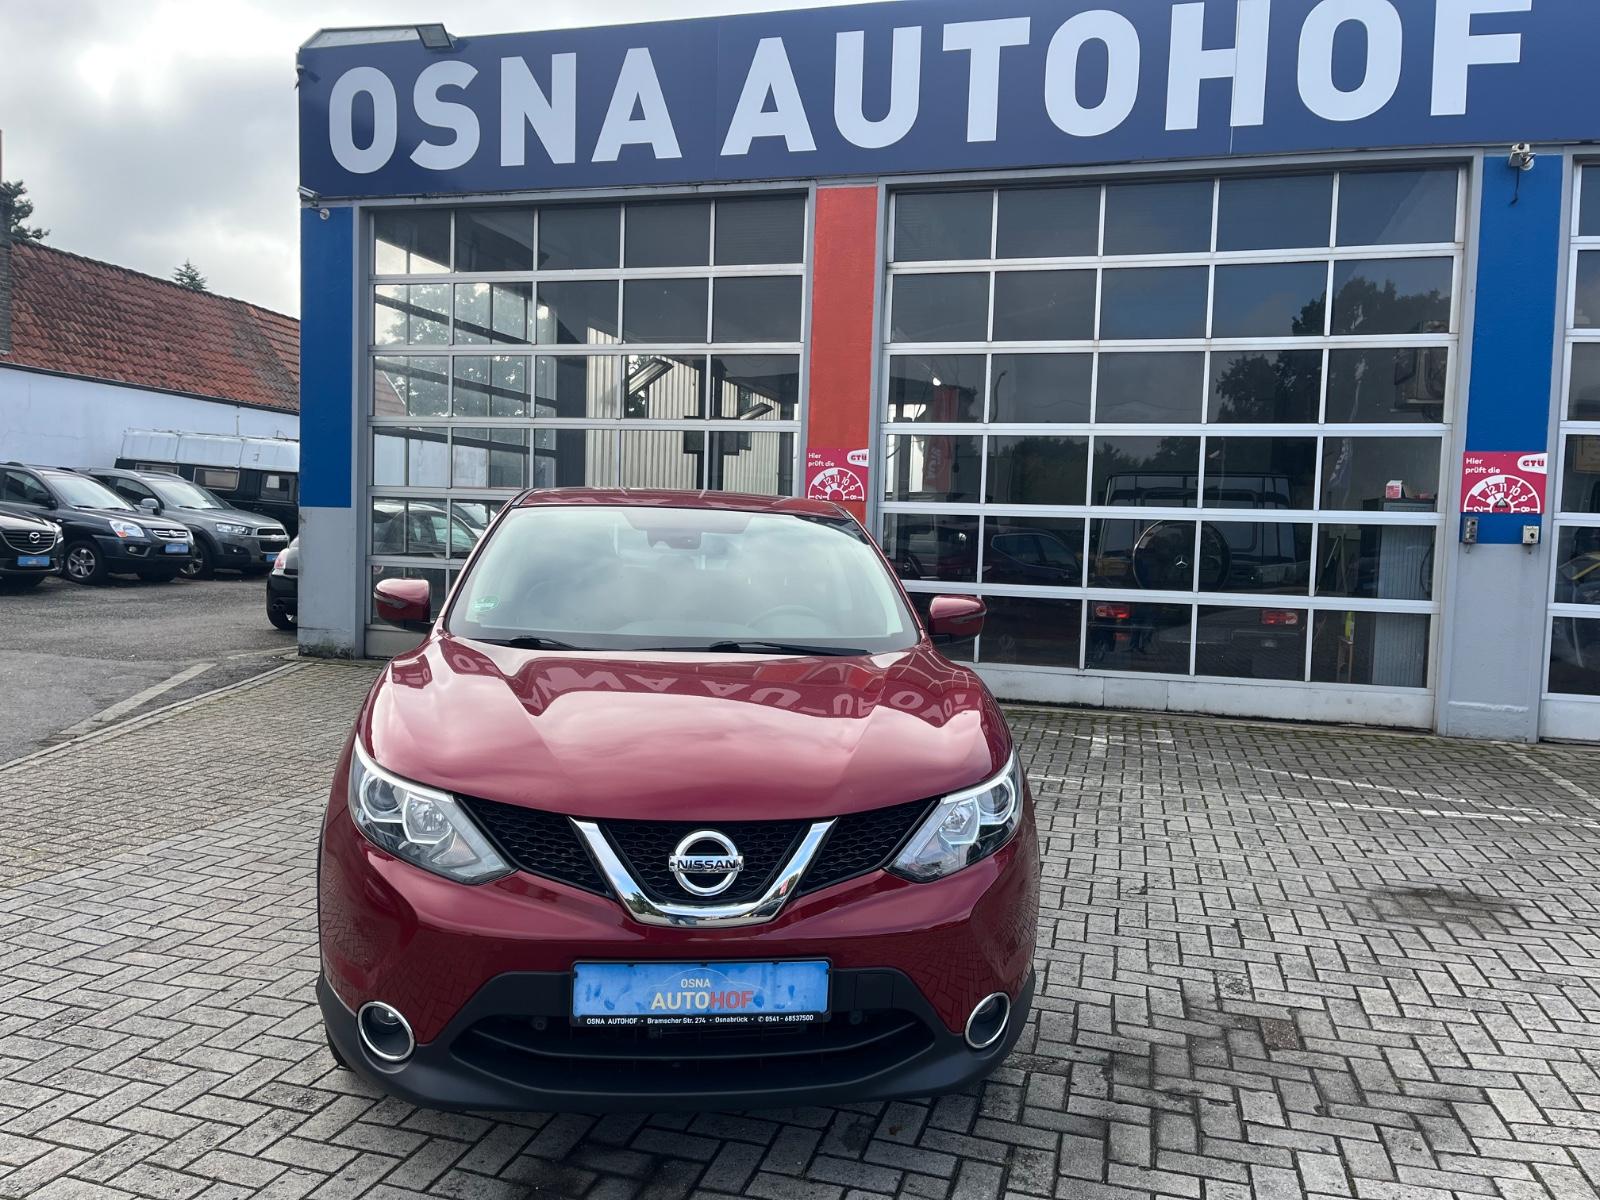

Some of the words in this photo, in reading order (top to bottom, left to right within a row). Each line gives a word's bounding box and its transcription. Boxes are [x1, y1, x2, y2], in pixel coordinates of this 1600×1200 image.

[329, 47, 683, 174] OSNA
[720, 0, 1532, 156] AUTOHOF
[1522, 458, 1544, 466] GTÜ
[1465, 467, 1487, 475] prüft
[824, 477, 832, 485] 12
[841, 476, 850, 486] 10
[1485, 485, 1497, 496] 12
[1499, 483, 1507, 492] 11
[1509, 485, 1521, 496] 10
[677, 859, 736, 870] NISSAN
[680, 978, 711, 989] OSNA
[650, 990, 754, 1010] AUTOHOF
[607, 1017, 638, 1025] AUTOHOF
